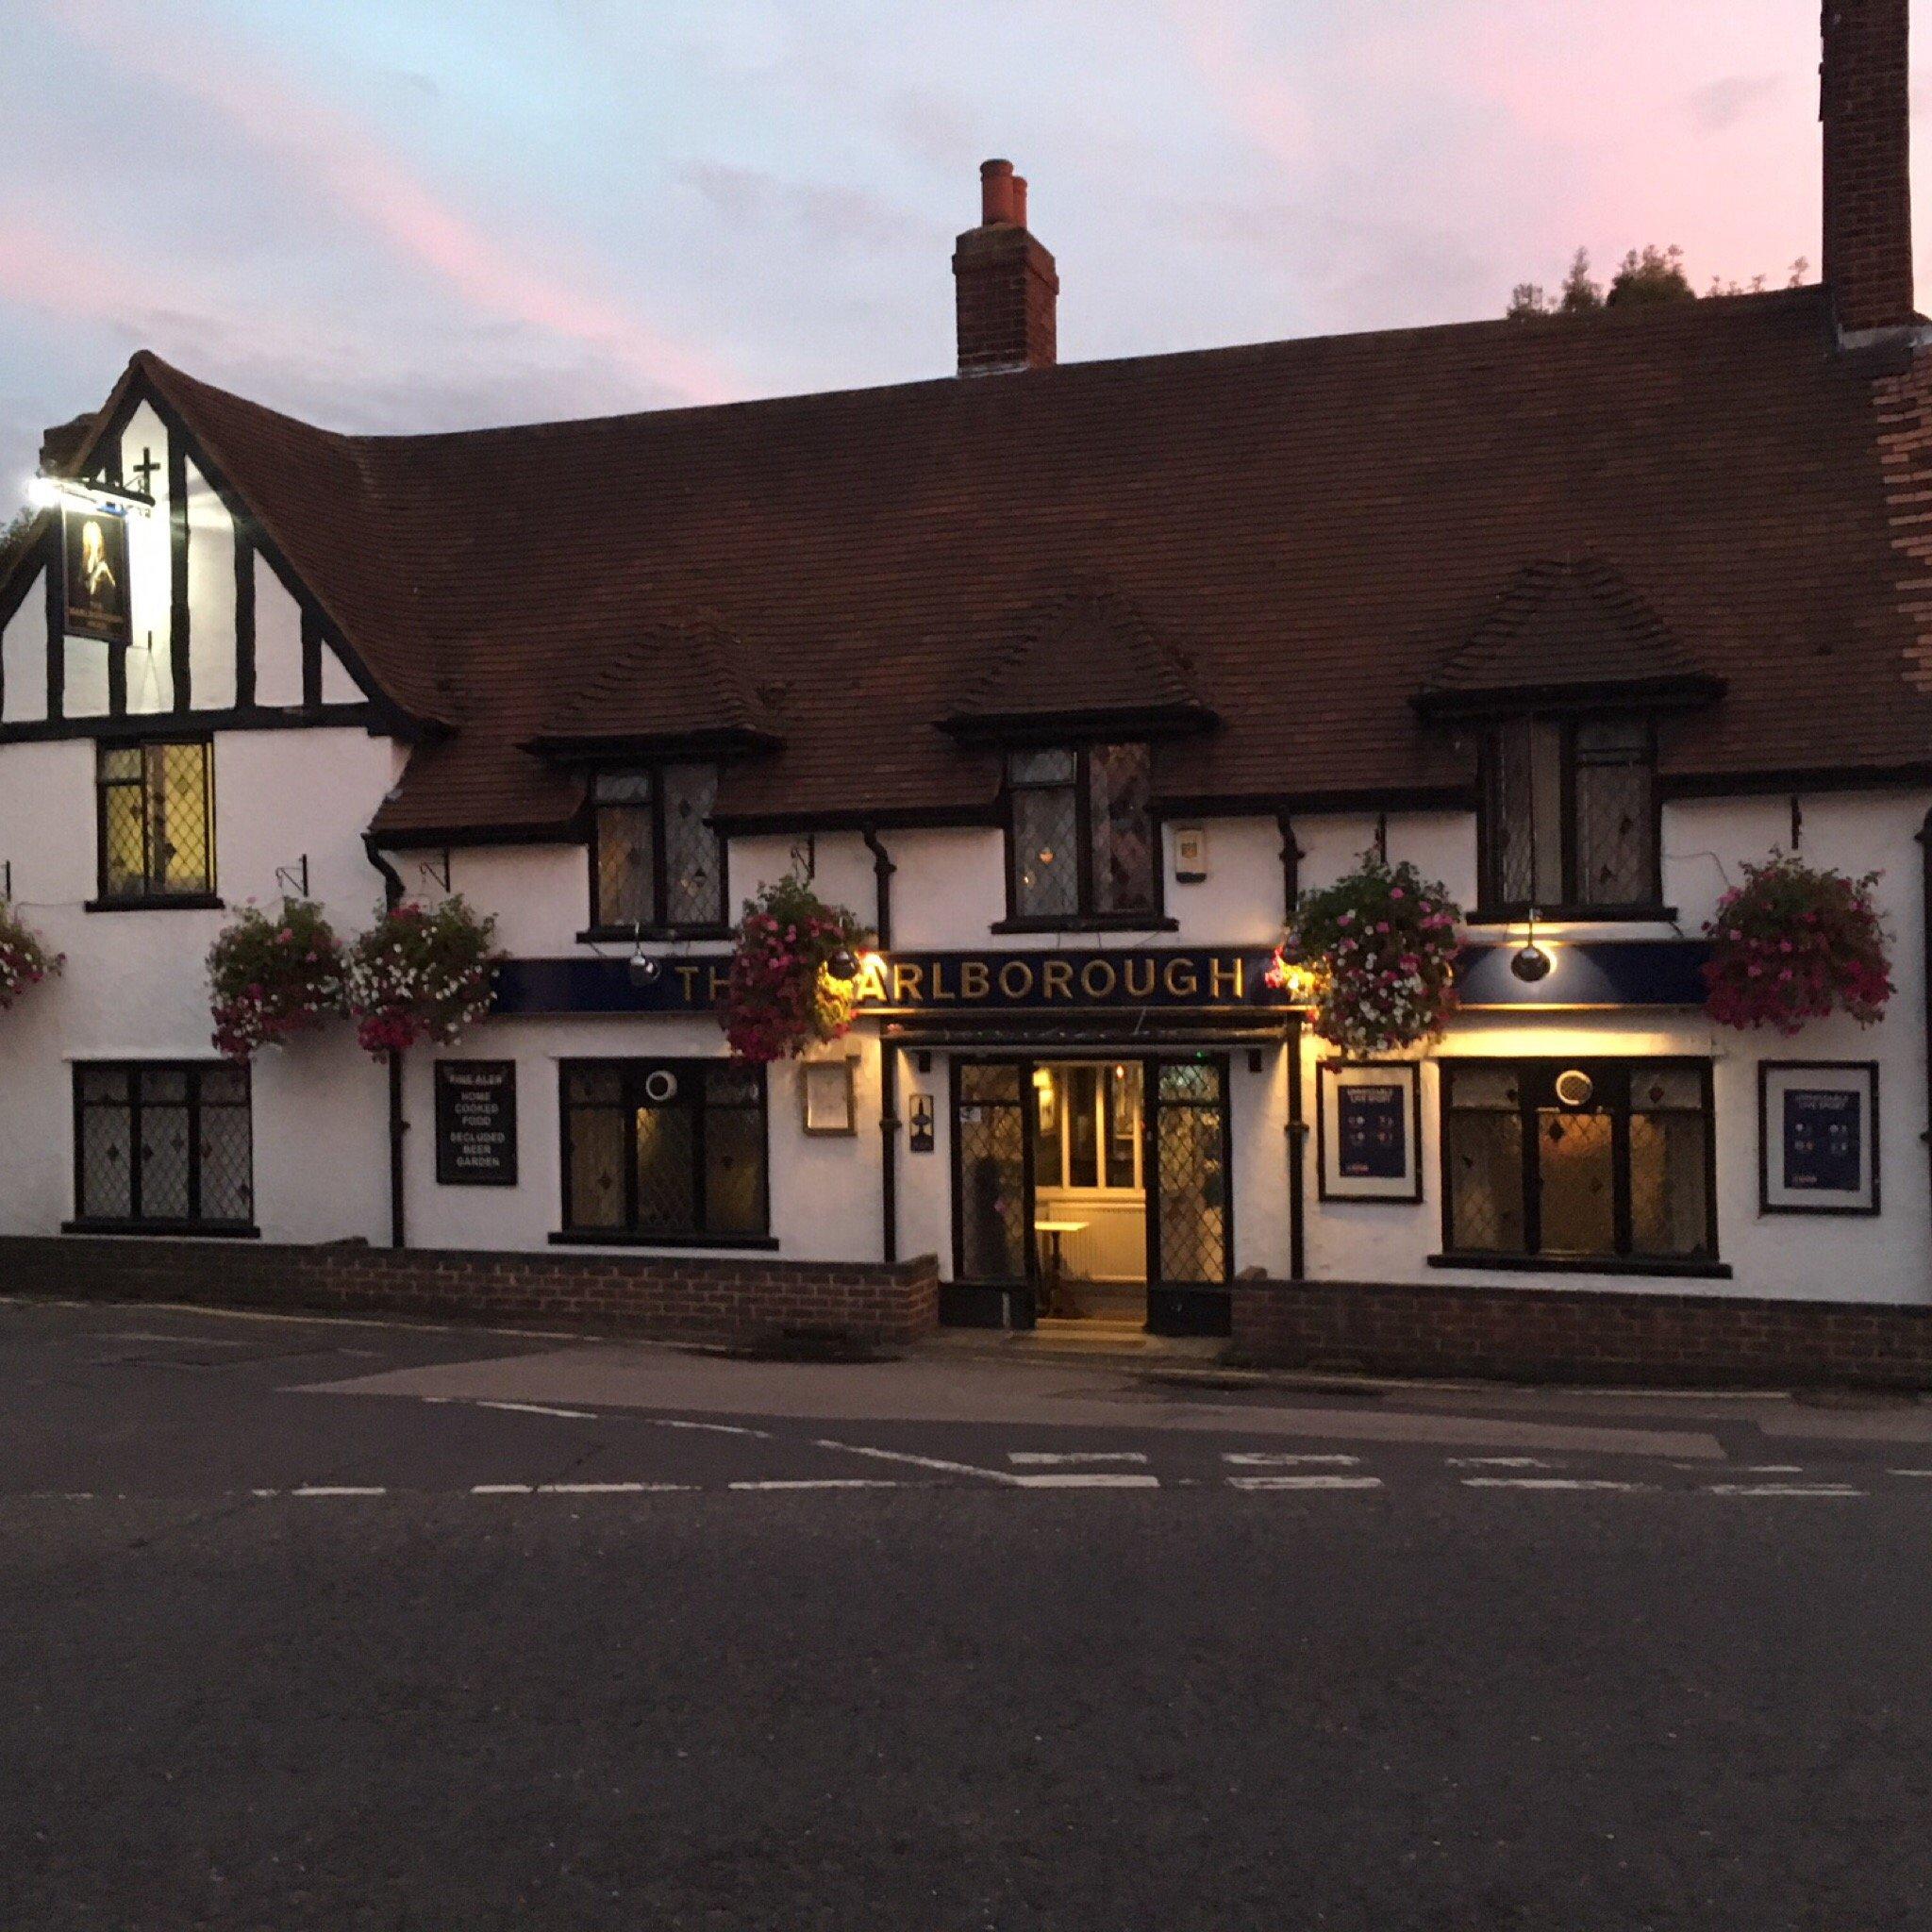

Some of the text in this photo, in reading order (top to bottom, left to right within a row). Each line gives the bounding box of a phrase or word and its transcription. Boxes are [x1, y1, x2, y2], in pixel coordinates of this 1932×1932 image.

[675, 957, 1243, 1002] TH ARLBOROUGH
[460, 1091, 491, 1102] HOME
[454, 1103, 499, 1114] COOKED
[461, 1115, 491, 1126] FOOD
[457, 1157, 501, 1168] GARDEN
